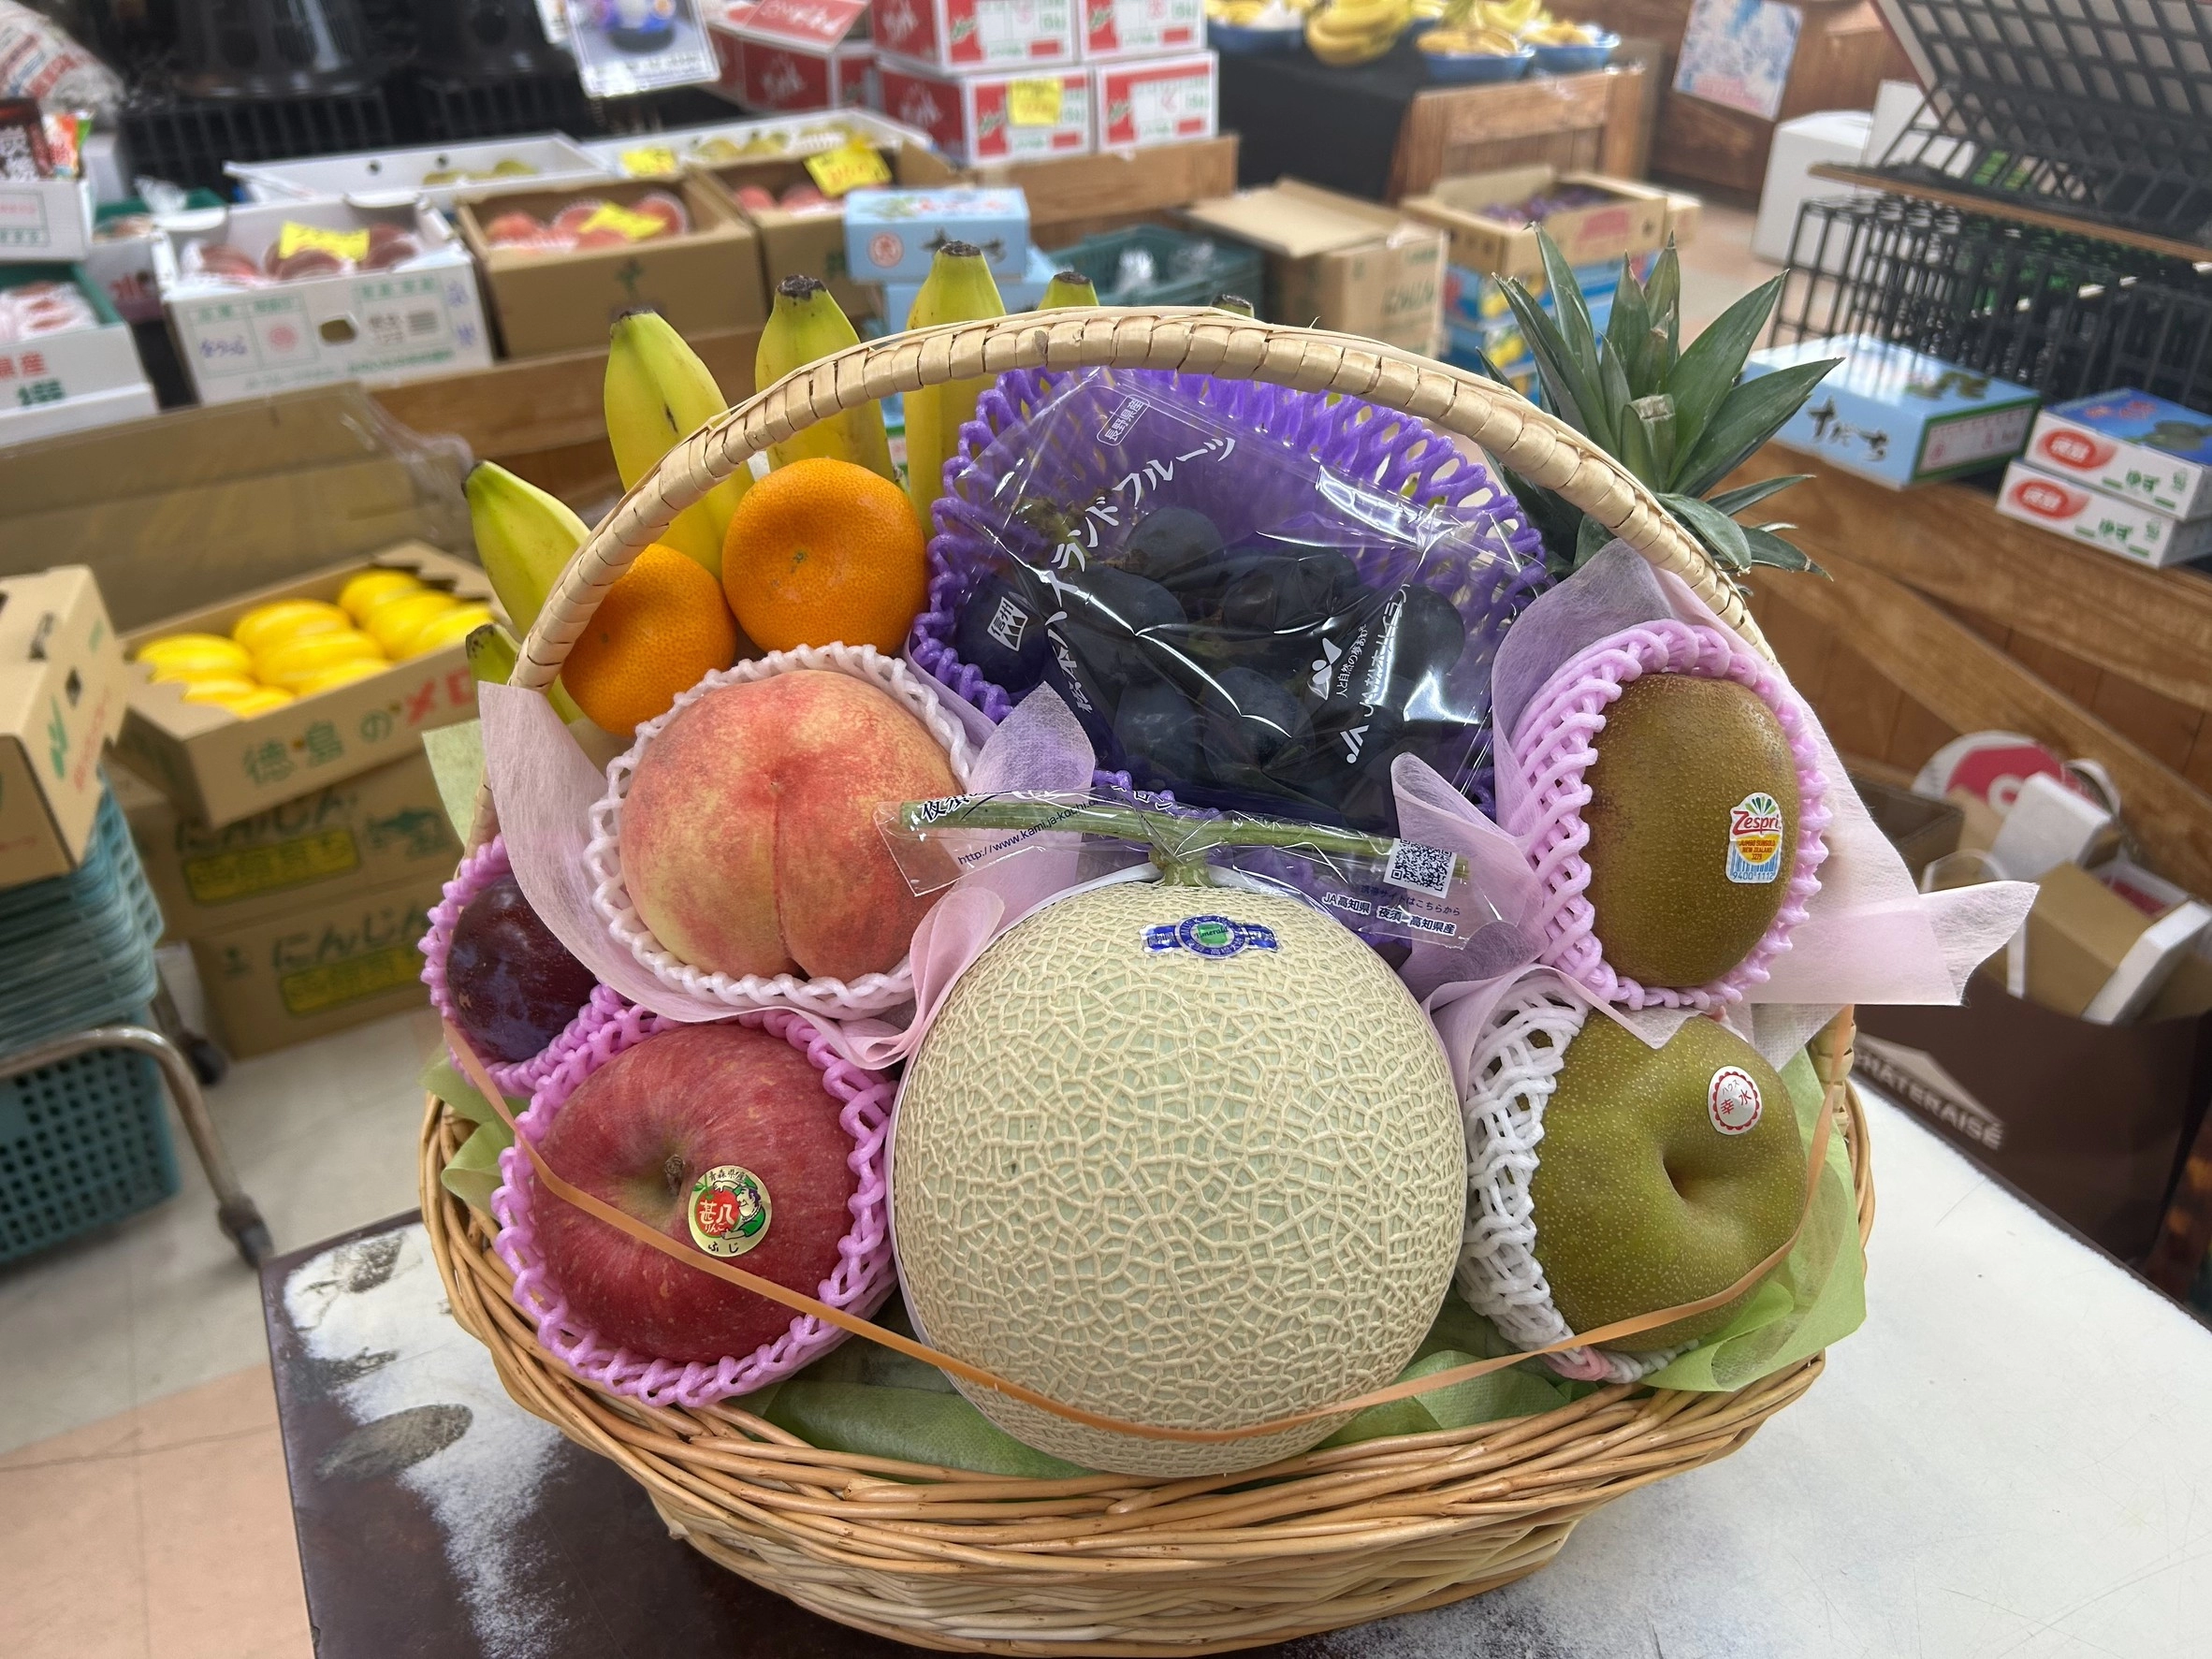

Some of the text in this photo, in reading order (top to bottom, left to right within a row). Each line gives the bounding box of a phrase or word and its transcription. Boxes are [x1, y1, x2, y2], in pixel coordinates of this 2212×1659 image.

[1104, 399, 1143, 442] 長野県産
[1360, 583, 1410, 718] JA松本ハイラン
[1732, 810, 1780, 835] Zespri
[1755, 838, 1776, 847] SUNGOLD
[1733, 871, 1754, 880] 9400
[1323, 893, 1456, 935] JA高知県 夜須 高知県産
[1193, 925, 1229, 938] Emerald
[1720, 1089, 1752, 1114] 幸水
[709, 1168, 746, 1183] 青森県産
[699, 1200, 735, 1226] 甚八
[705, 1221, 728, 1233] りんご
[707, 1241, 739, 1253] ふじ
